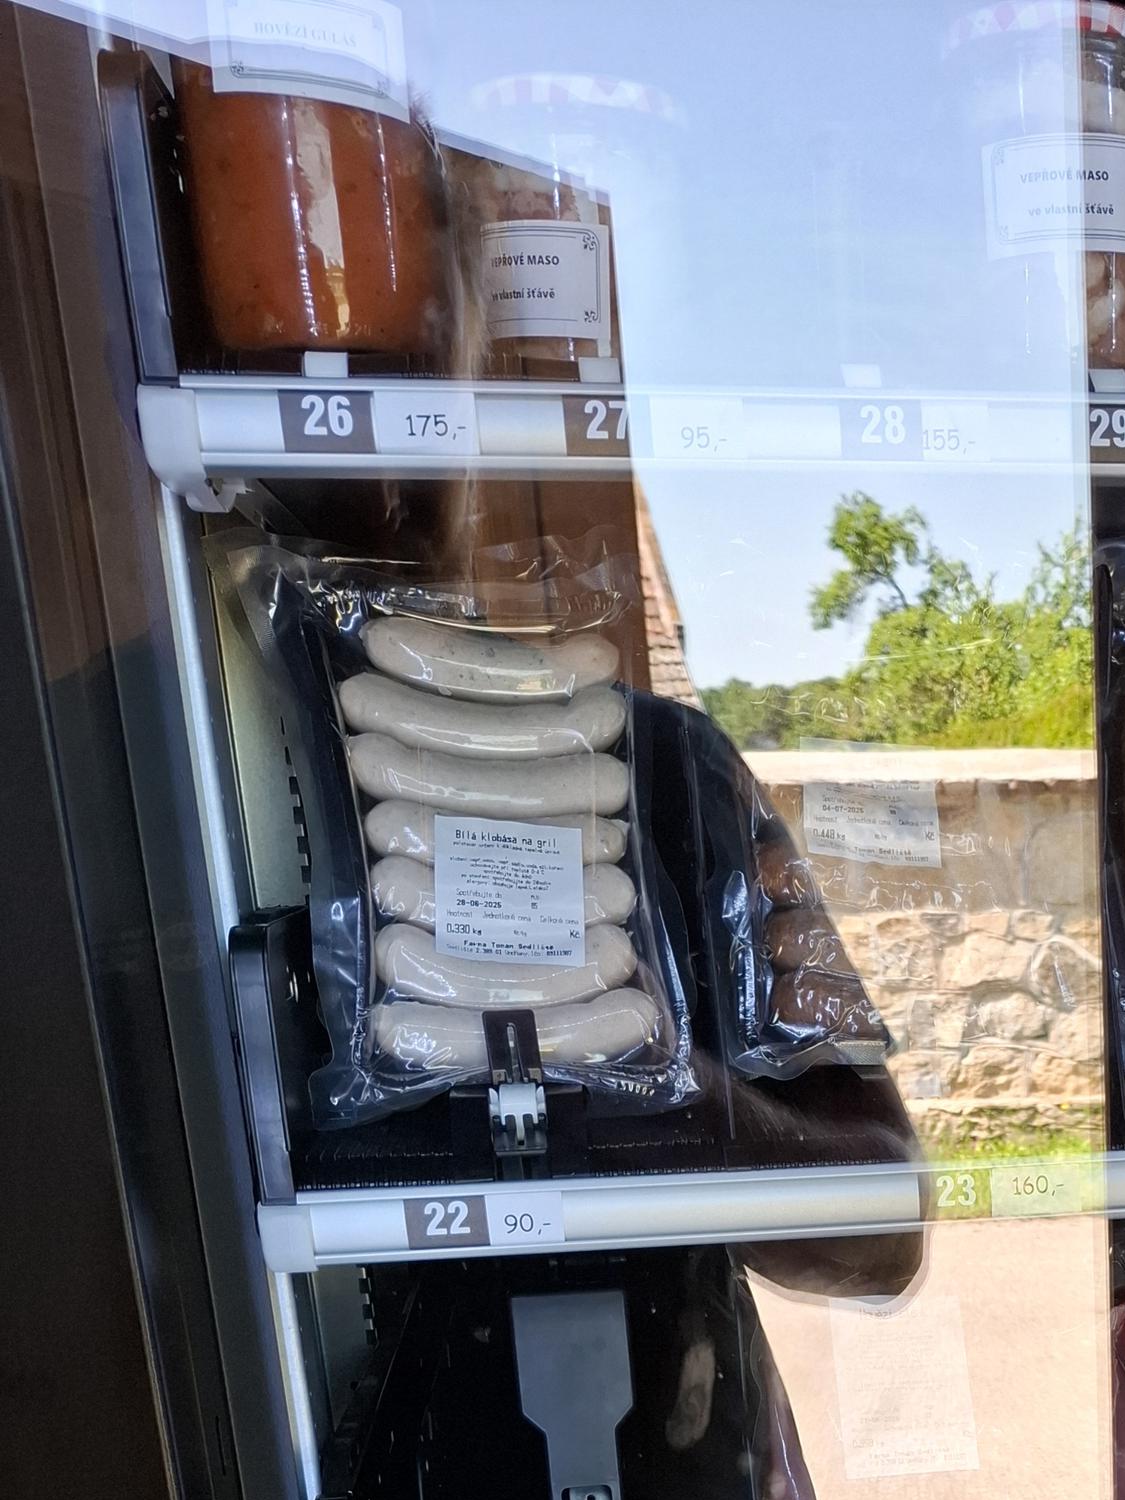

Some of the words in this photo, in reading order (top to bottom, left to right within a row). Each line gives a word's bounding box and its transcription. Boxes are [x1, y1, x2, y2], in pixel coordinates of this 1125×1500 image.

[1020, 167, 1073, 184] VEPŘOVÉ
[1076, 169, 1109, 181] MASO
[1085, 202, 1114, 215] šťávě
[527, 255, 560, 266] MASO
[527, 288, 556, 299] šťávě
[300, 395, 353, 436] 26
[584, 400, 630, 440] 27
[859, 405, 906, 445] 28
[405, 415, 467, 440] 175,-
[681, 426, 728, 452] 95,-
[922, 428, 976, 455] 155,-
[455, 829, 478, 841] Bílá
[481, 832, 517, 844] klobása
[521, 837, 532, 846] na
[537, 838, 556, 849] gril
[455, 898, 502, 909] 28-06-2025
[446, 922, 470, 934] 0.330
[472, 927, 482, 935] kg
[936, 1174, 977, 1208] 23
[1012, 1175, 1065, 1197] 160,-
[423, 1200, 471, 1236] 22
[504, 1213, 552, 1236] 90,-
